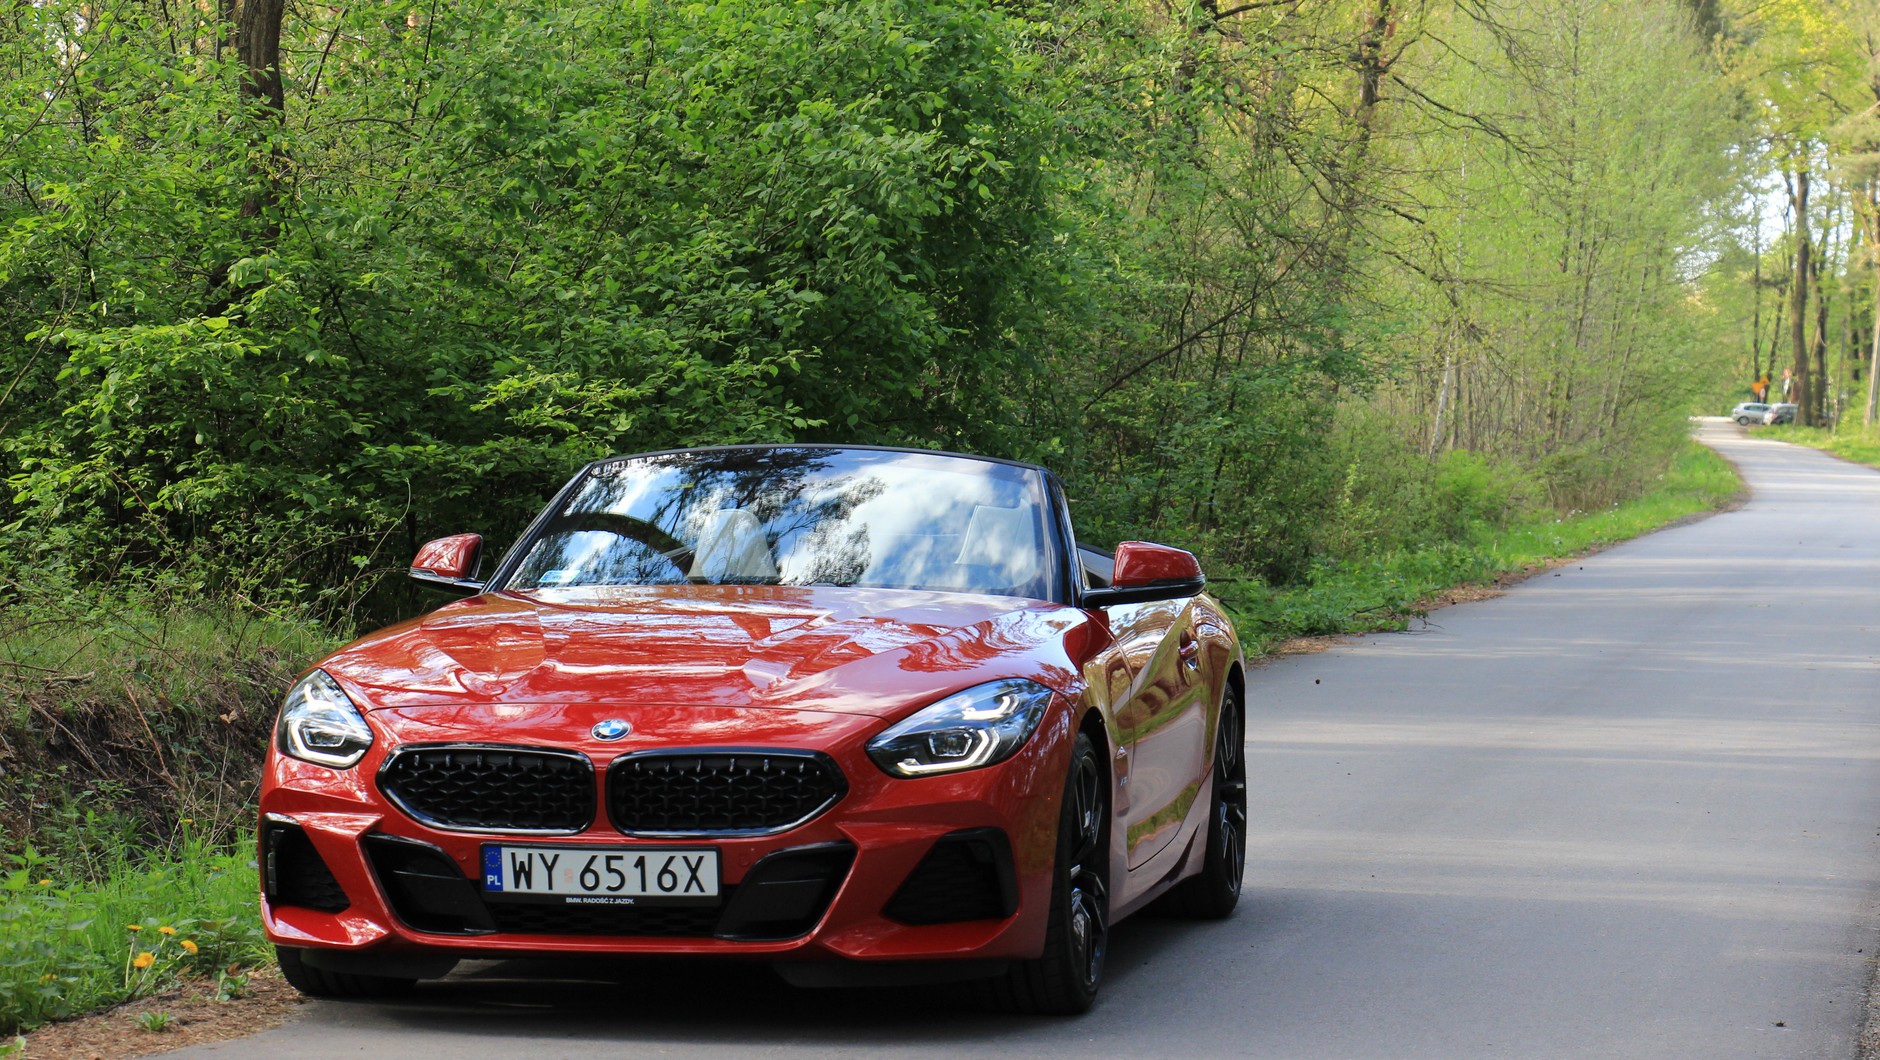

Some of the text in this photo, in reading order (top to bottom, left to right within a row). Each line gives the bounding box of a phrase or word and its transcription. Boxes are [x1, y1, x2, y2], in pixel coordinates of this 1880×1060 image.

[487, 875, 501, 886] PL
[510, 852, 706, 893] WY 6516X
